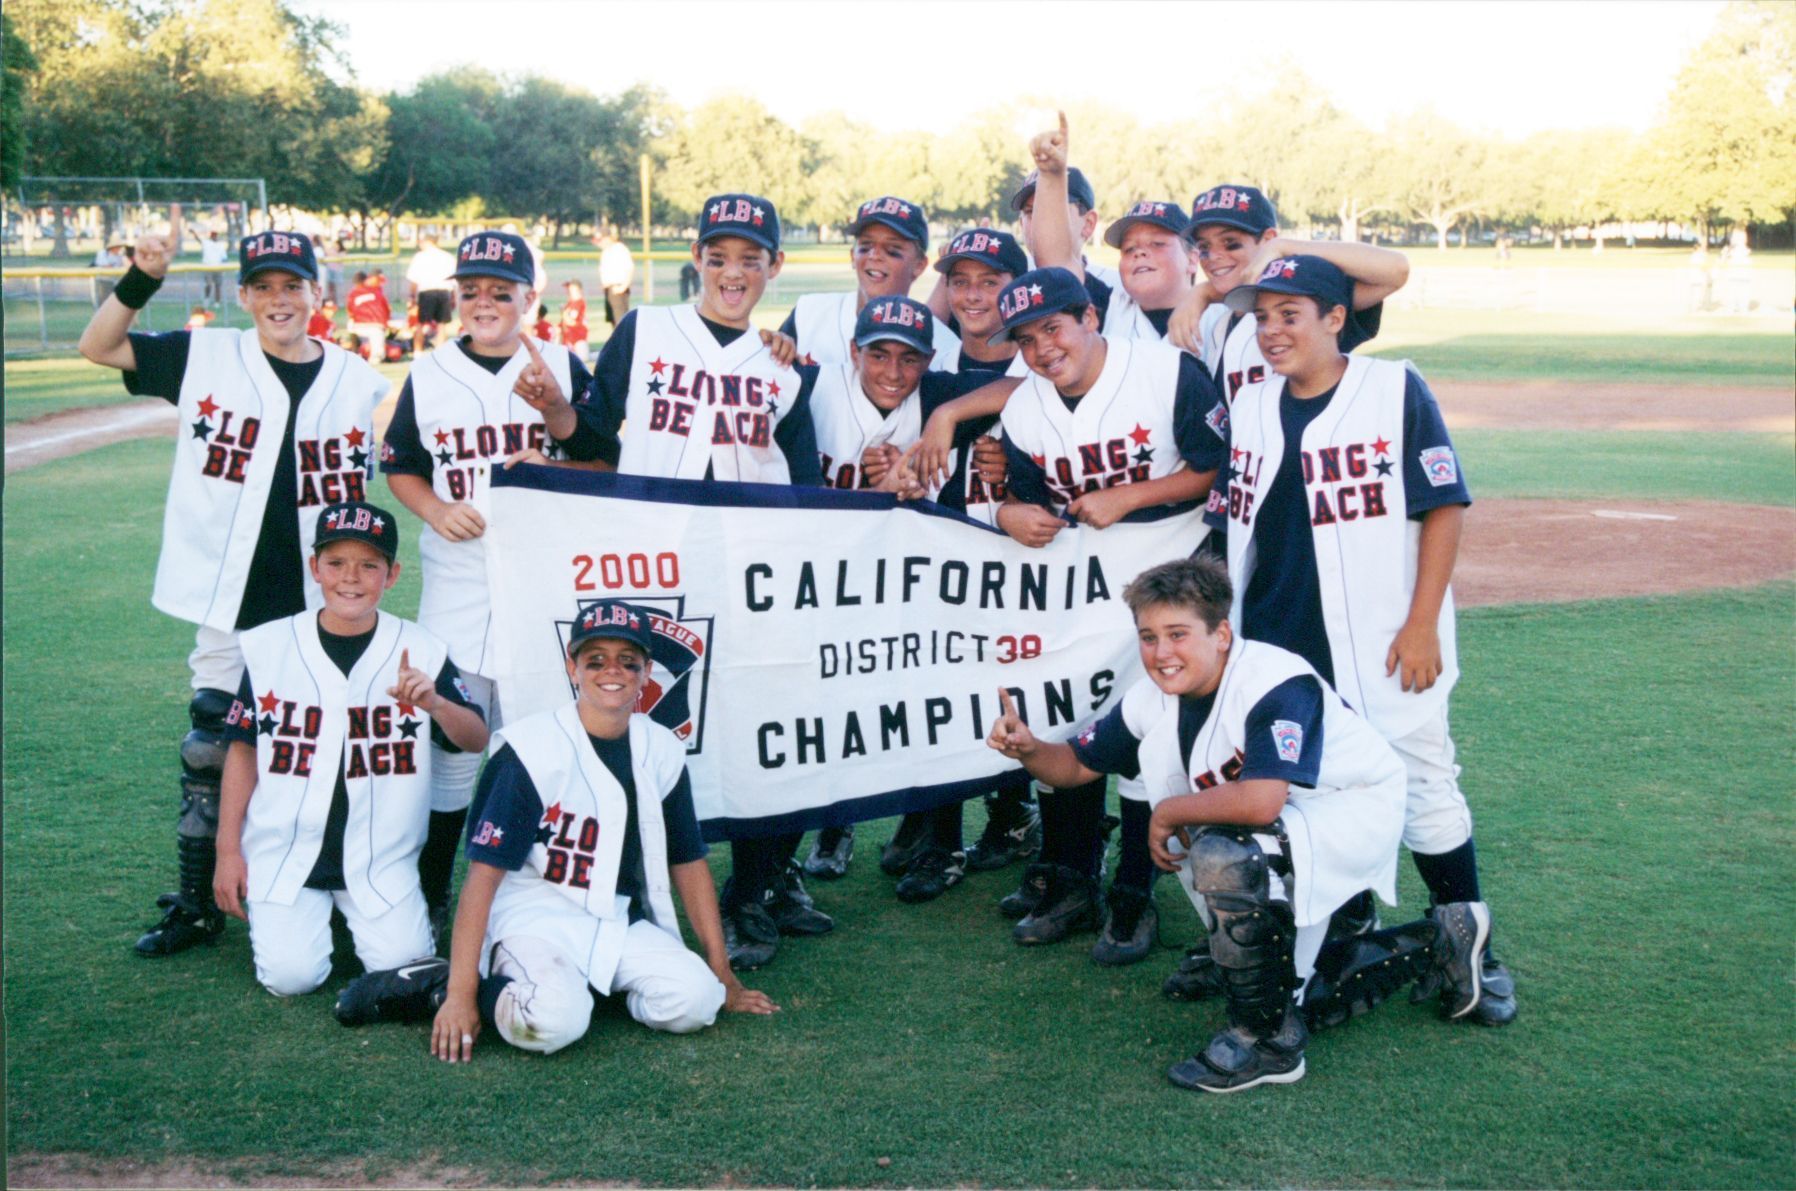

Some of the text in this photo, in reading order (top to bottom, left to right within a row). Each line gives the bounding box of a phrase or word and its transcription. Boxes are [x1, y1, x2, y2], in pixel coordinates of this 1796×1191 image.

[718, 199, 751, 223] LB
[868, 198, 900, 214] LB
[1203, 187, 1235, 209] LB
[257, 233, 291, 256] LB
[468, 237, 503, 261] LB
[957, 233, 989, 252] LB
[883, 302, 913, 327] LB
[1003, 285, 1029, 319] LB
[667, 363, 764, 408] LONG
[452, 422, 547, 461] LONG
[1046, 438, 1129, 487] ONG
[336, 508, 371, 531] LB
[1311, 481, 1388, 526] ACH
[571, 551, 680, 591] 2000
[745, 555, 1111, 613] CALIFORNIA
[594, 605, 628, 627] LB
[650, 617, 698, 647] AGUE
[819, 630, 1042, 679] DISTRICT 38
[756, 668, 1116, 769] CHAMPIONS
[553, 811, 600, 853] LO
[543, 847, 595, 890] BE
